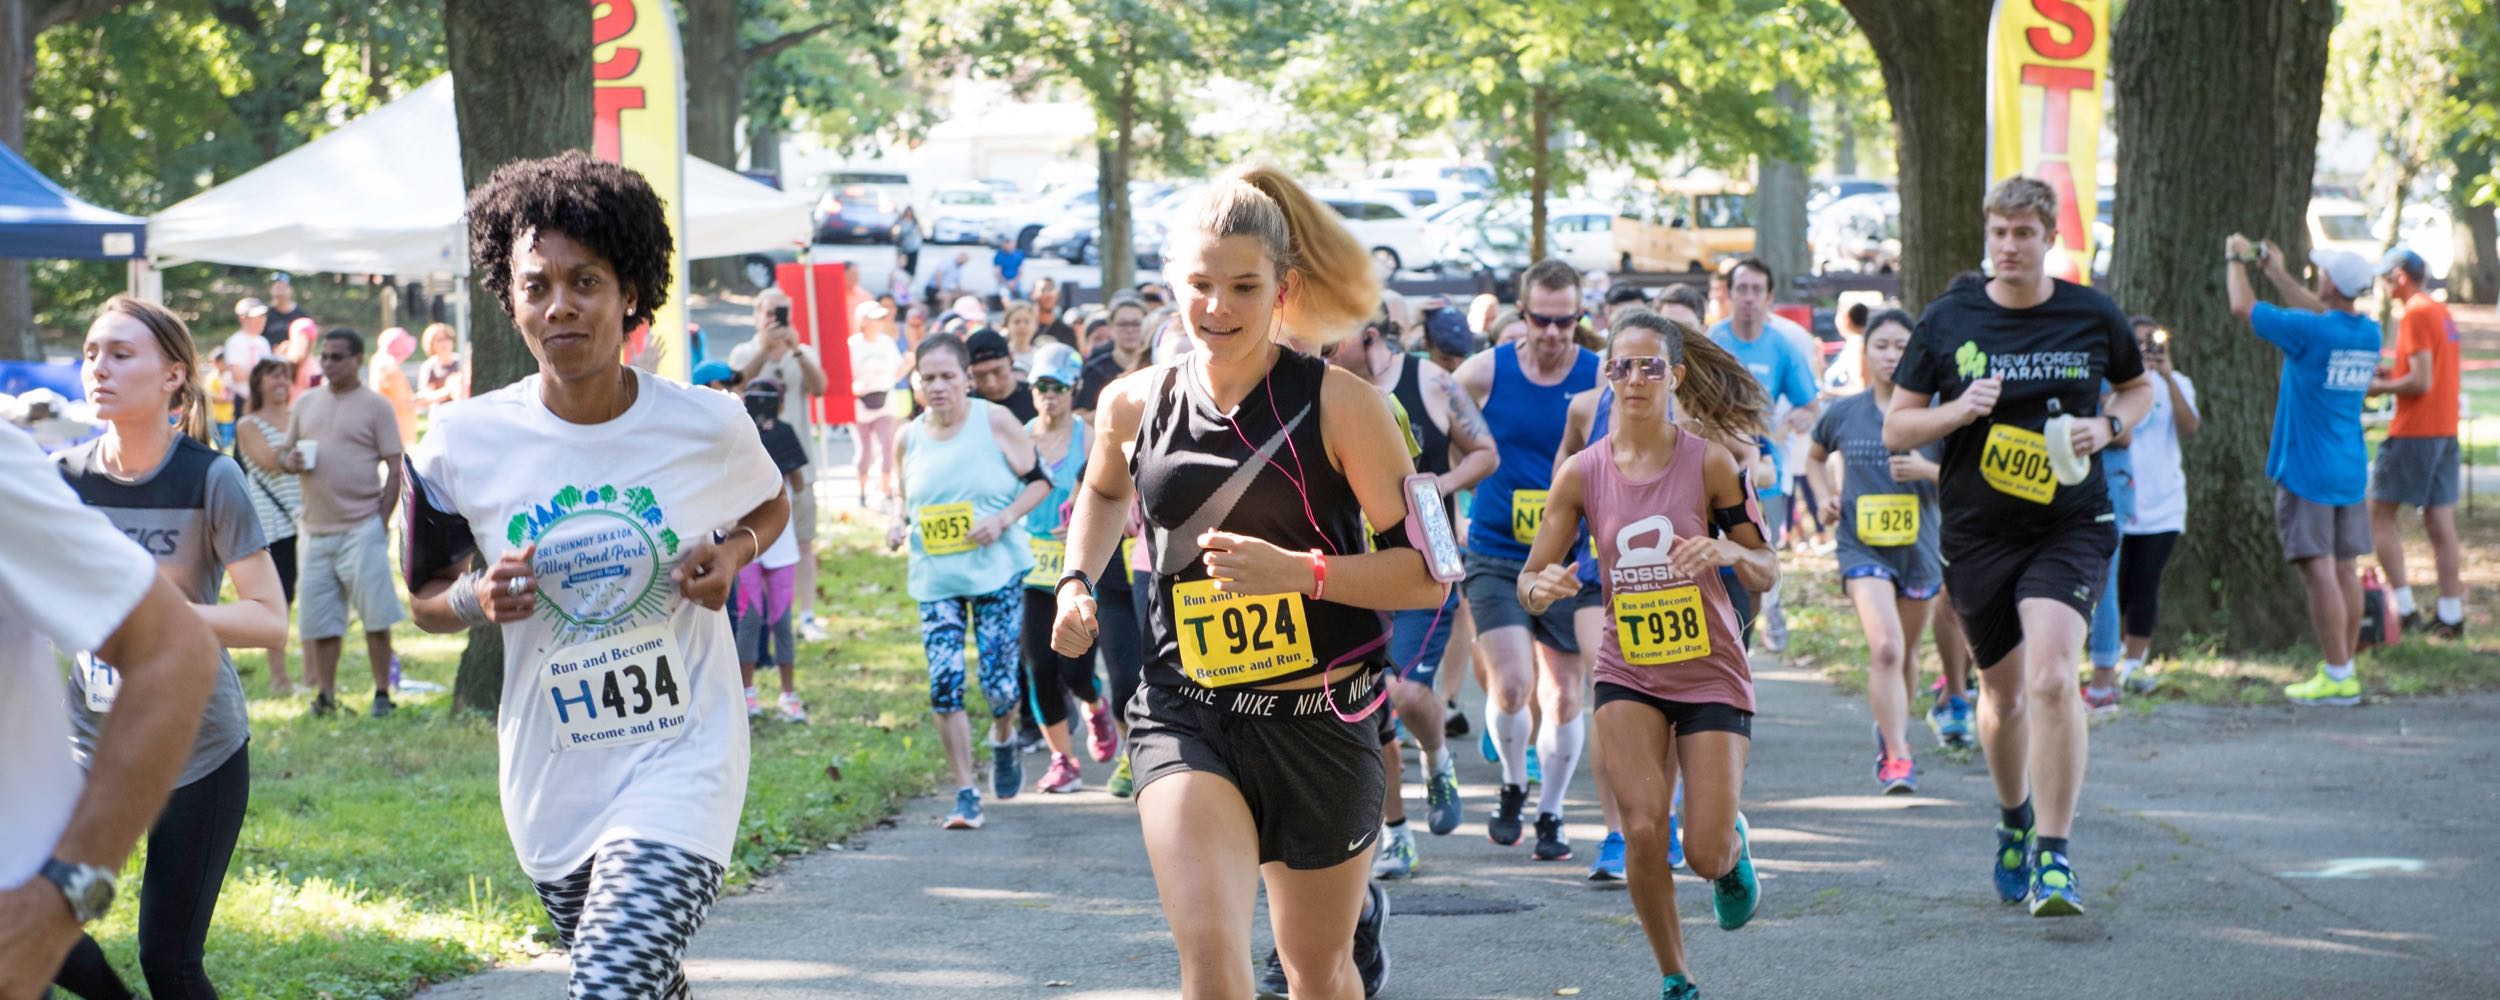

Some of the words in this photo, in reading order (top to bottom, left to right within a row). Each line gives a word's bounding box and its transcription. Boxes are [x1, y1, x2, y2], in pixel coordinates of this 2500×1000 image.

[2020, 0, 2096, 286] STA
[1990, 352, 2031, 367] NEW
[2032, 351, 2091, 367] FOREST
[1985, 444, 2052, 484] N905
[920, 515, 970, 540] W953
[535, 557, 572, 578] Alley
[573, 544, 609, 569] Pond
[611, 540, 647, 561] Park
[537, 546, 553, 560] SRI
[554, 535, 594, 555] CHINMOY
[1183, 594, 1206, 607] Run
[1210, 592, 1233, 603] and
[1621, 601, 1638, 611] Run
[1640, 598, 1656, 609] and
[1658, 595, 1693, 607] Become
[551, 662, 578, 676] Run
[582, 651, 608, 669] and
[611, 637, 664, 662] Become
[1195, 664, 1246, 680] Become
[1250, 657, 1273, 672] and
[1276, 652, 1301, 666] Run
[1630, 650, 1663, 660] Become
[1666, 646, 1682, 657] and
[1685, 644, 1702, 653] Run
[1230, 692, 1279, 717] NIKE
[1293, 688, 1337, 717] NIKE
[1348, 666, 1372, 705] NIKE
[571, 726, 625, 744] Become
[630, 720, 655, 734] and
[658, 713, 685, 730] Run
